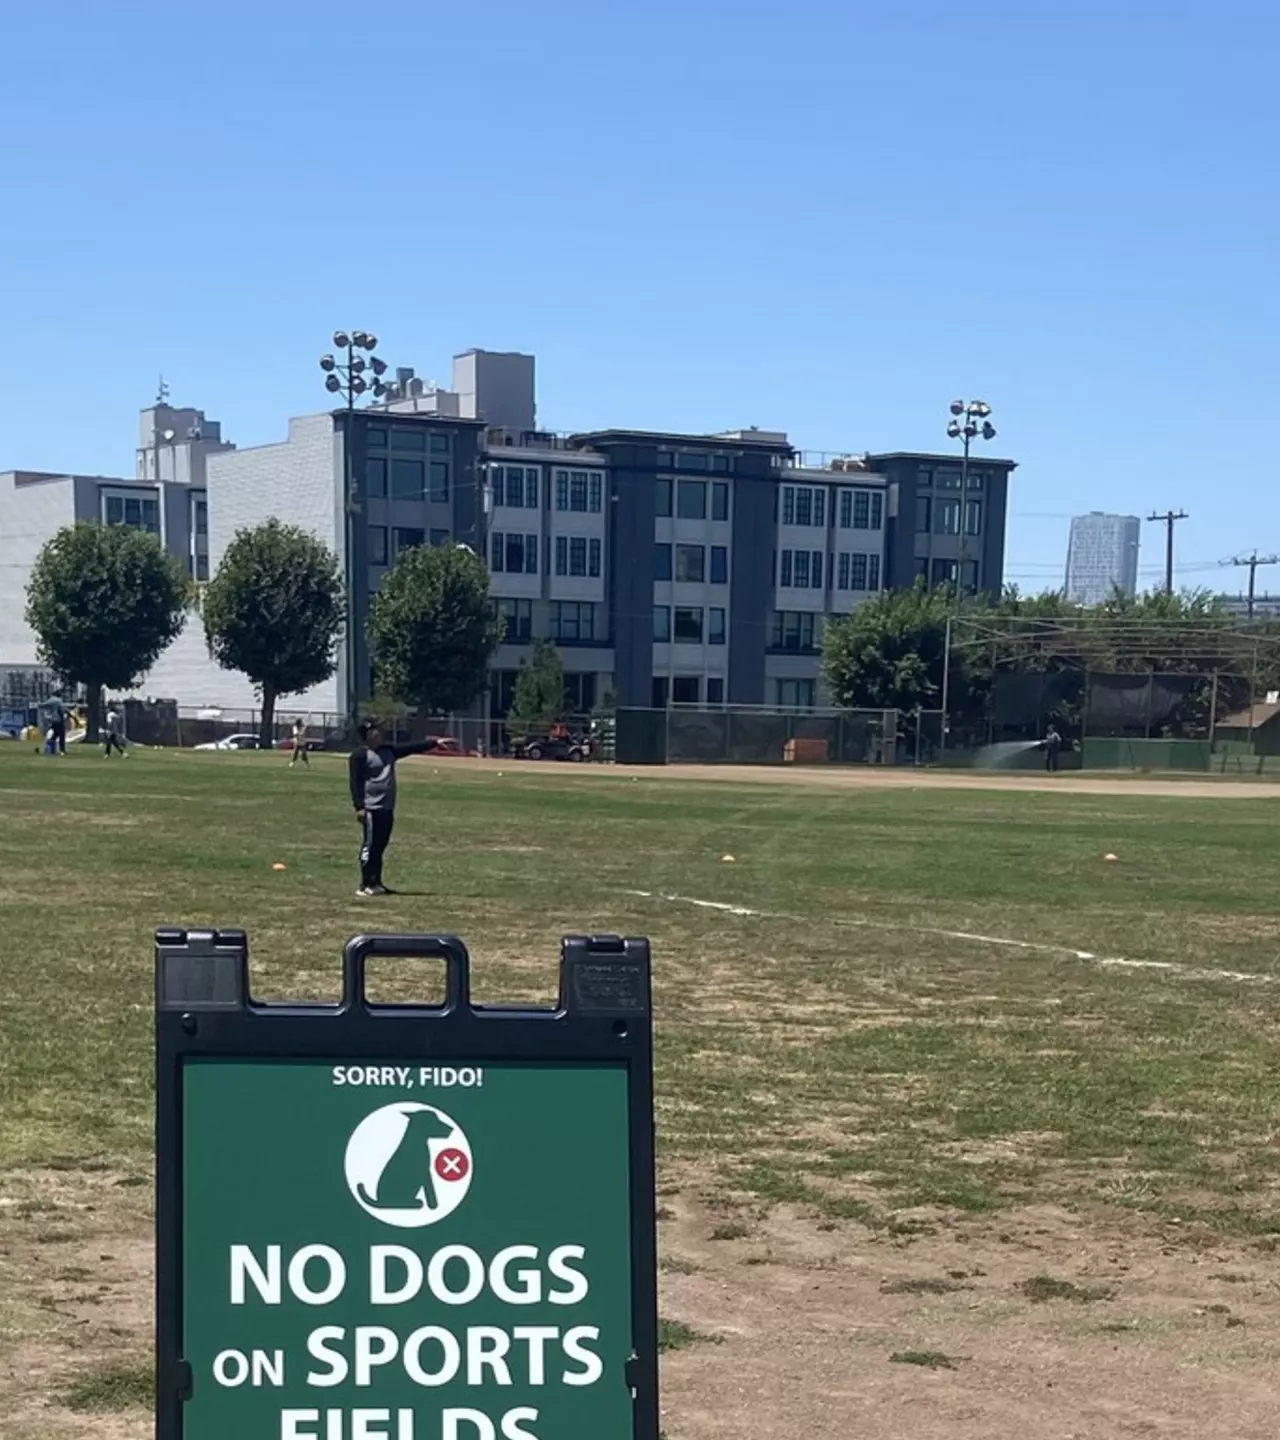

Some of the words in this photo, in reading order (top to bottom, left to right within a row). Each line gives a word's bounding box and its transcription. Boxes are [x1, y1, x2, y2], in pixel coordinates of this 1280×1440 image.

[332, 1066, 414, 1089] SORRY,
[420, 1067, 483, 1087] FIDO!
[230, 1244, 346, 1305] NO
[370, 1244, 589, 1305] DOGS
[212, 1349, 284, 1387] ON
[306, 1325, 603, 1387] SPORTS
